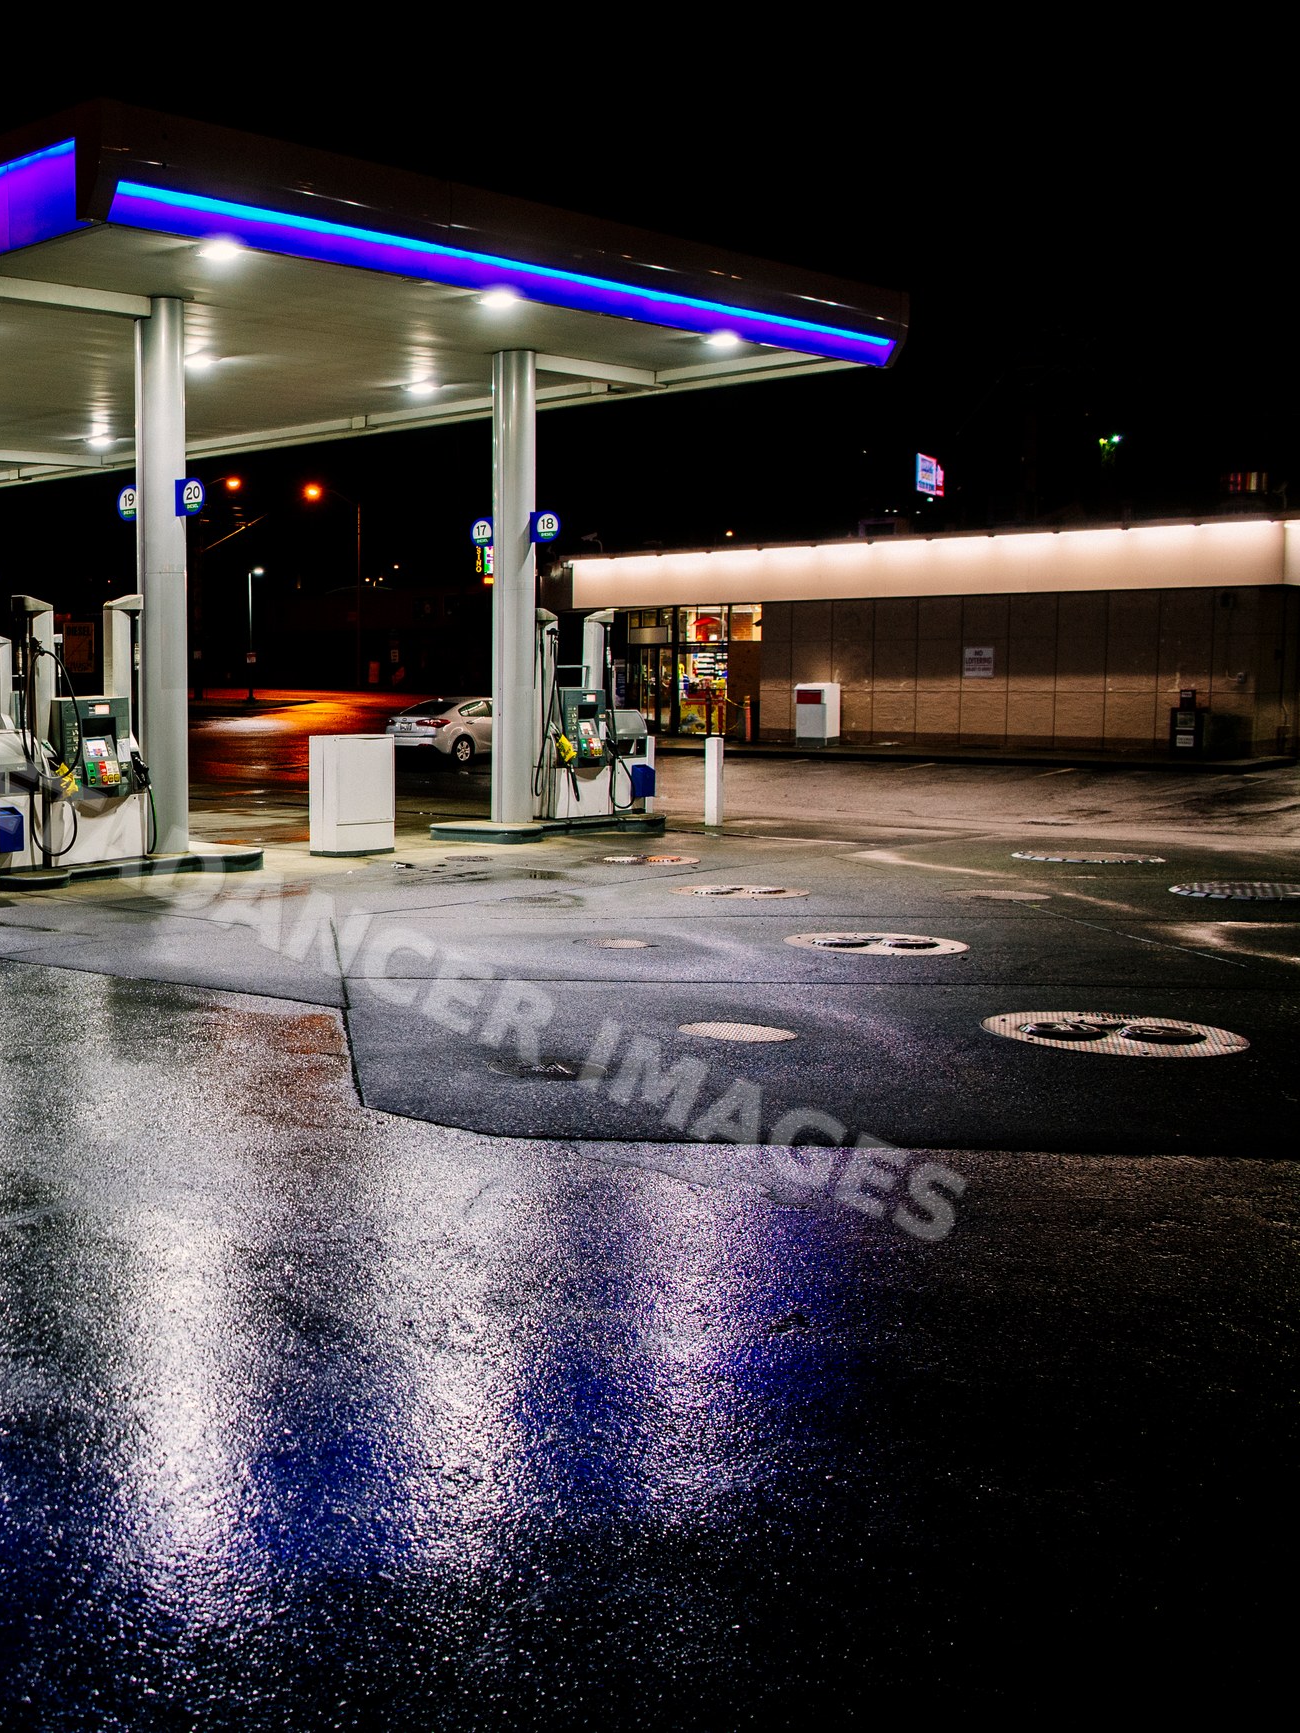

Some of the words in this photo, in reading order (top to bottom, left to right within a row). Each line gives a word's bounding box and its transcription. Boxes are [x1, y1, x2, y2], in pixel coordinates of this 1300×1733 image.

[186, 485, 200, 501] 20
[123, 493, 135, 507] 19
[476, 525, 487, 536] 17
[541, 518, 554, 530] 18
